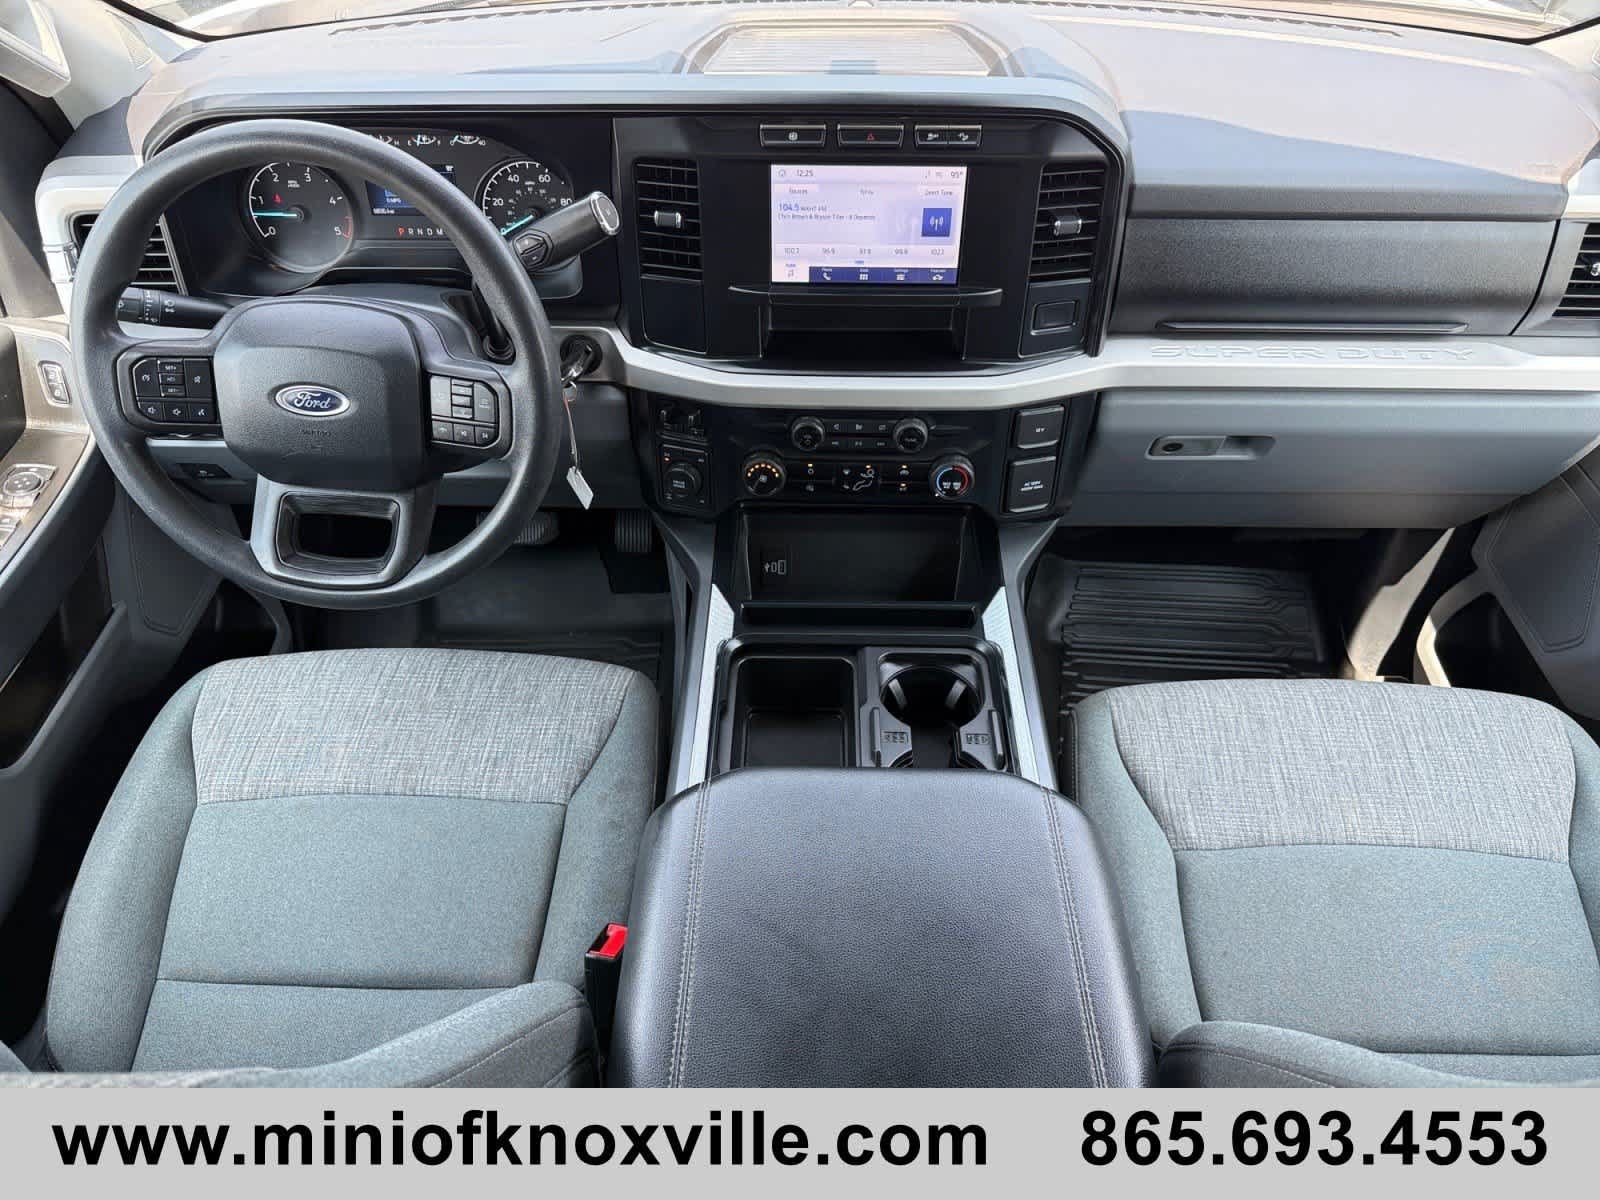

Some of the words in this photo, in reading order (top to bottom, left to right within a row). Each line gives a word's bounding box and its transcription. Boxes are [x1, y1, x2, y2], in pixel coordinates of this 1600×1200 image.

[271, 173, 280, 182] 2
[304, 173, 311, 182] 3
[796, 169, 814, 177] 12:25
[507, 174, 519, 183] 40
[538, 174, 551, 183] 60
[258, 195, 264, 205] 1
[329, 196, 337, 206] 4
[492, 197, 504, 207] 20
[268, 226, 276, 236] 0
[334, 226, 342, 236] 5
[398, 227, 405, 236] P
[408, 227, 414, 236] R
[417, 227, 423, 236] N
[427, 227, 433, 236] D
[436, 227, 443, 236] M
[1151, 345, 1329, 360] SUPER
[1337, 347, 1474, 361] DUTY
[294, 391, 331, 409] Ford
